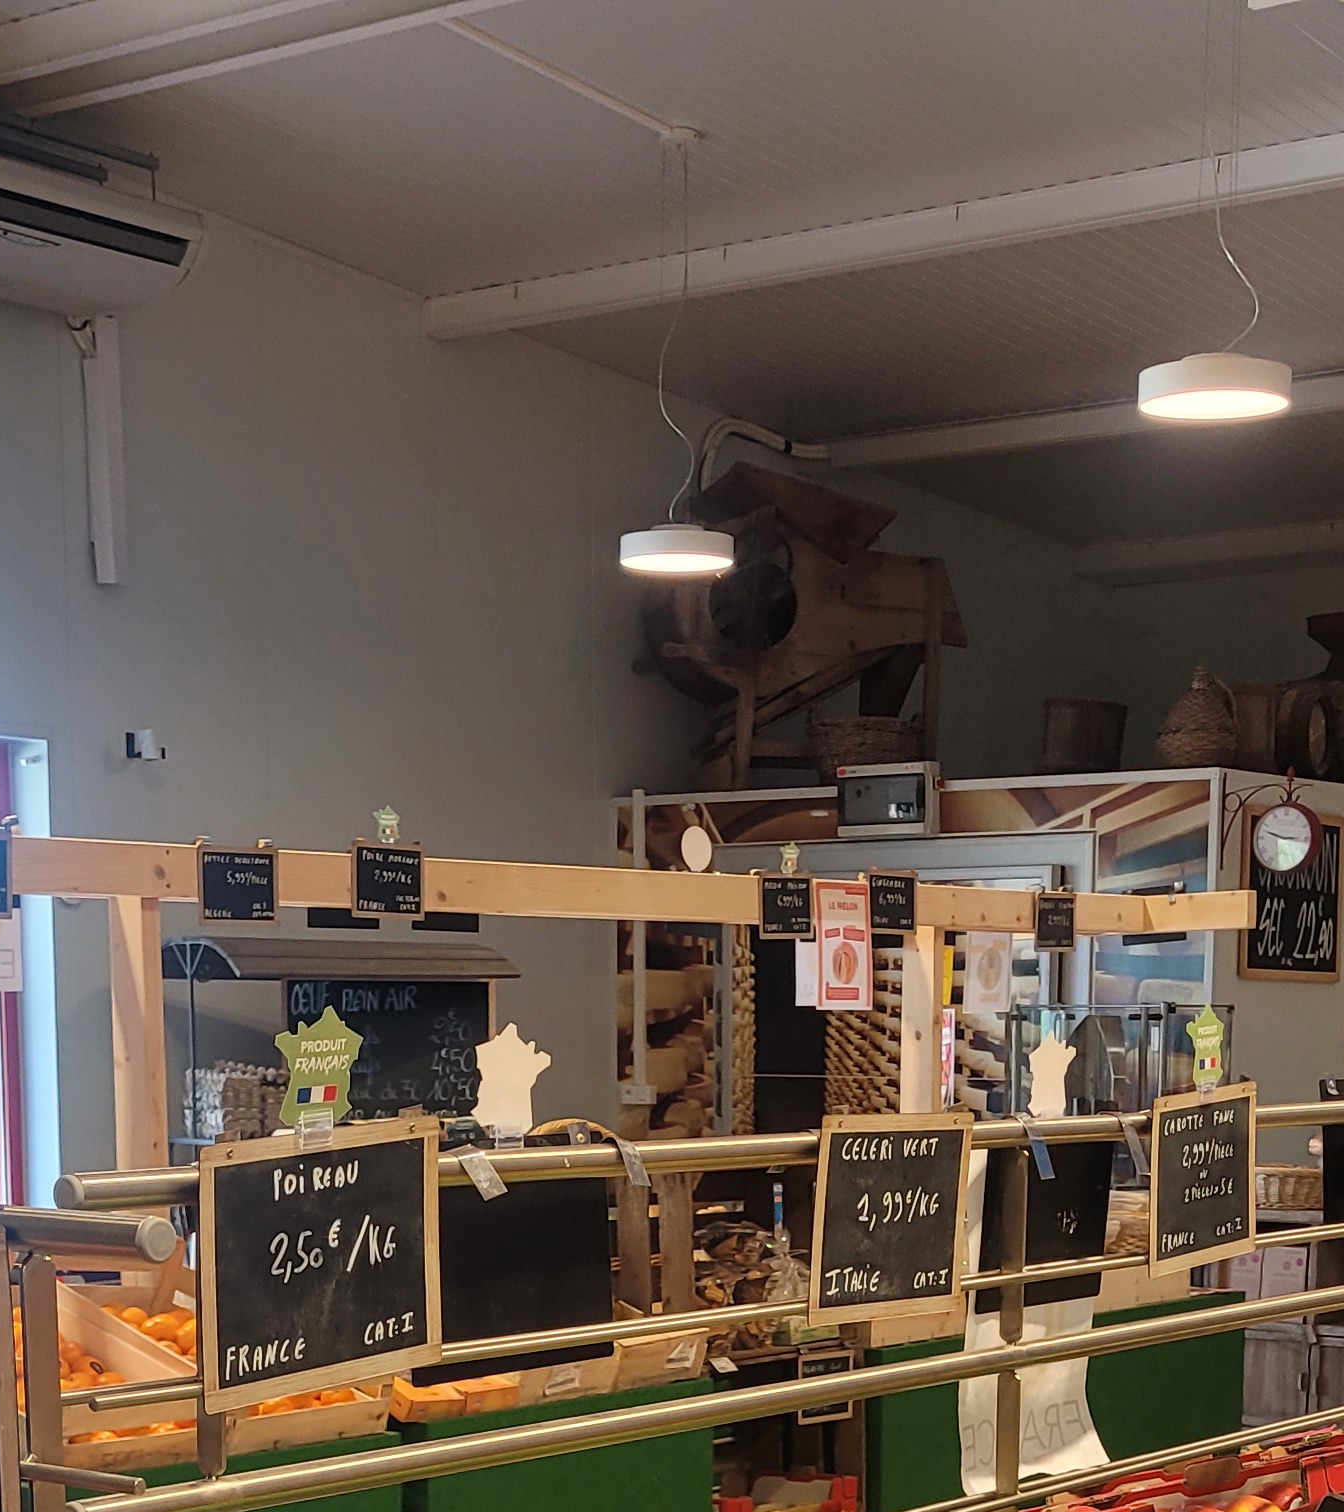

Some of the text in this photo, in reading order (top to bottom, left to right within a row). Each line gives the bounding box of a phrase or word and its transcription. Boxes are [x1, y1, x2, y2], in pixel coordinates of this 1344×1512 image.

[836, 900, 859, 911] MELON
[1257, 897, 1285, 957] SEC
[384, 985, 418, 1010] AIR
[300, 1038, 347, 1053] PRODUIT
[294, 1054, 350, 1078] FRANÇAIS
[1164, 1114, 1204, 1136] CAROTTE
[903, 1137, 939, 1158] VERT
[1161, 1231, 1195, 1254] FRANCE
[225, 1337, 307, 1381] FRANCE
